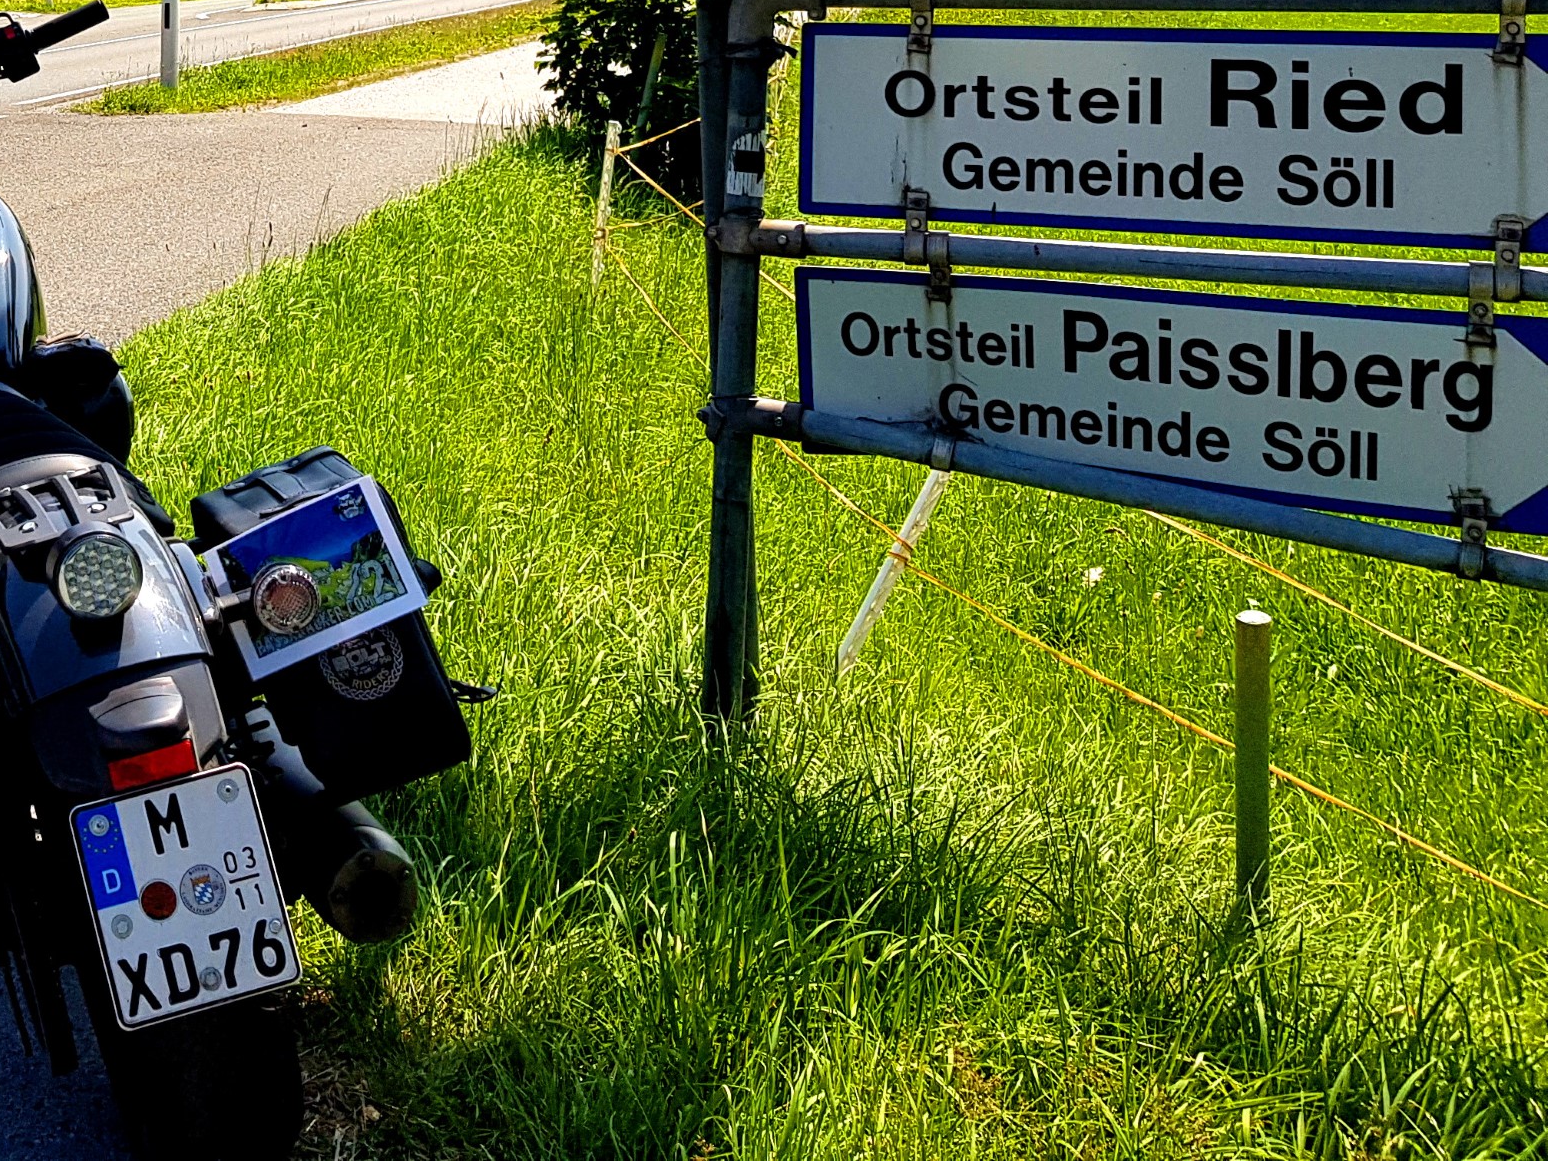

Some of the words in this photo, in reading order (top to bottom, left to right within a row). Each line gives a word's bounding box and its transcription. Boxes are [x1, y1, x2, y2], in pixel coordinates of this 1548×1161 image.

[884, 69, 1163, 126] Ortsteil
[1209, 58, 1464, 135] Ried
[942, 141, 1244, 203] Gemeinde
[1276, 154, 1394, 209] Söll
[840, 310, 1035, 370] Ortsteil
[1062, 309, 1495, 432] Paisslberg
[938, 383, 1231, 464] Gemeinde
[1262, 420, 1379, 481] Söll
[352, 668, 390, 689] RIDERS
[144, 792, 190, 855] M
[102, 868, 121, 894] D
[223, 846, 257, 874] 03
[234, 883, 265, 910] 11
